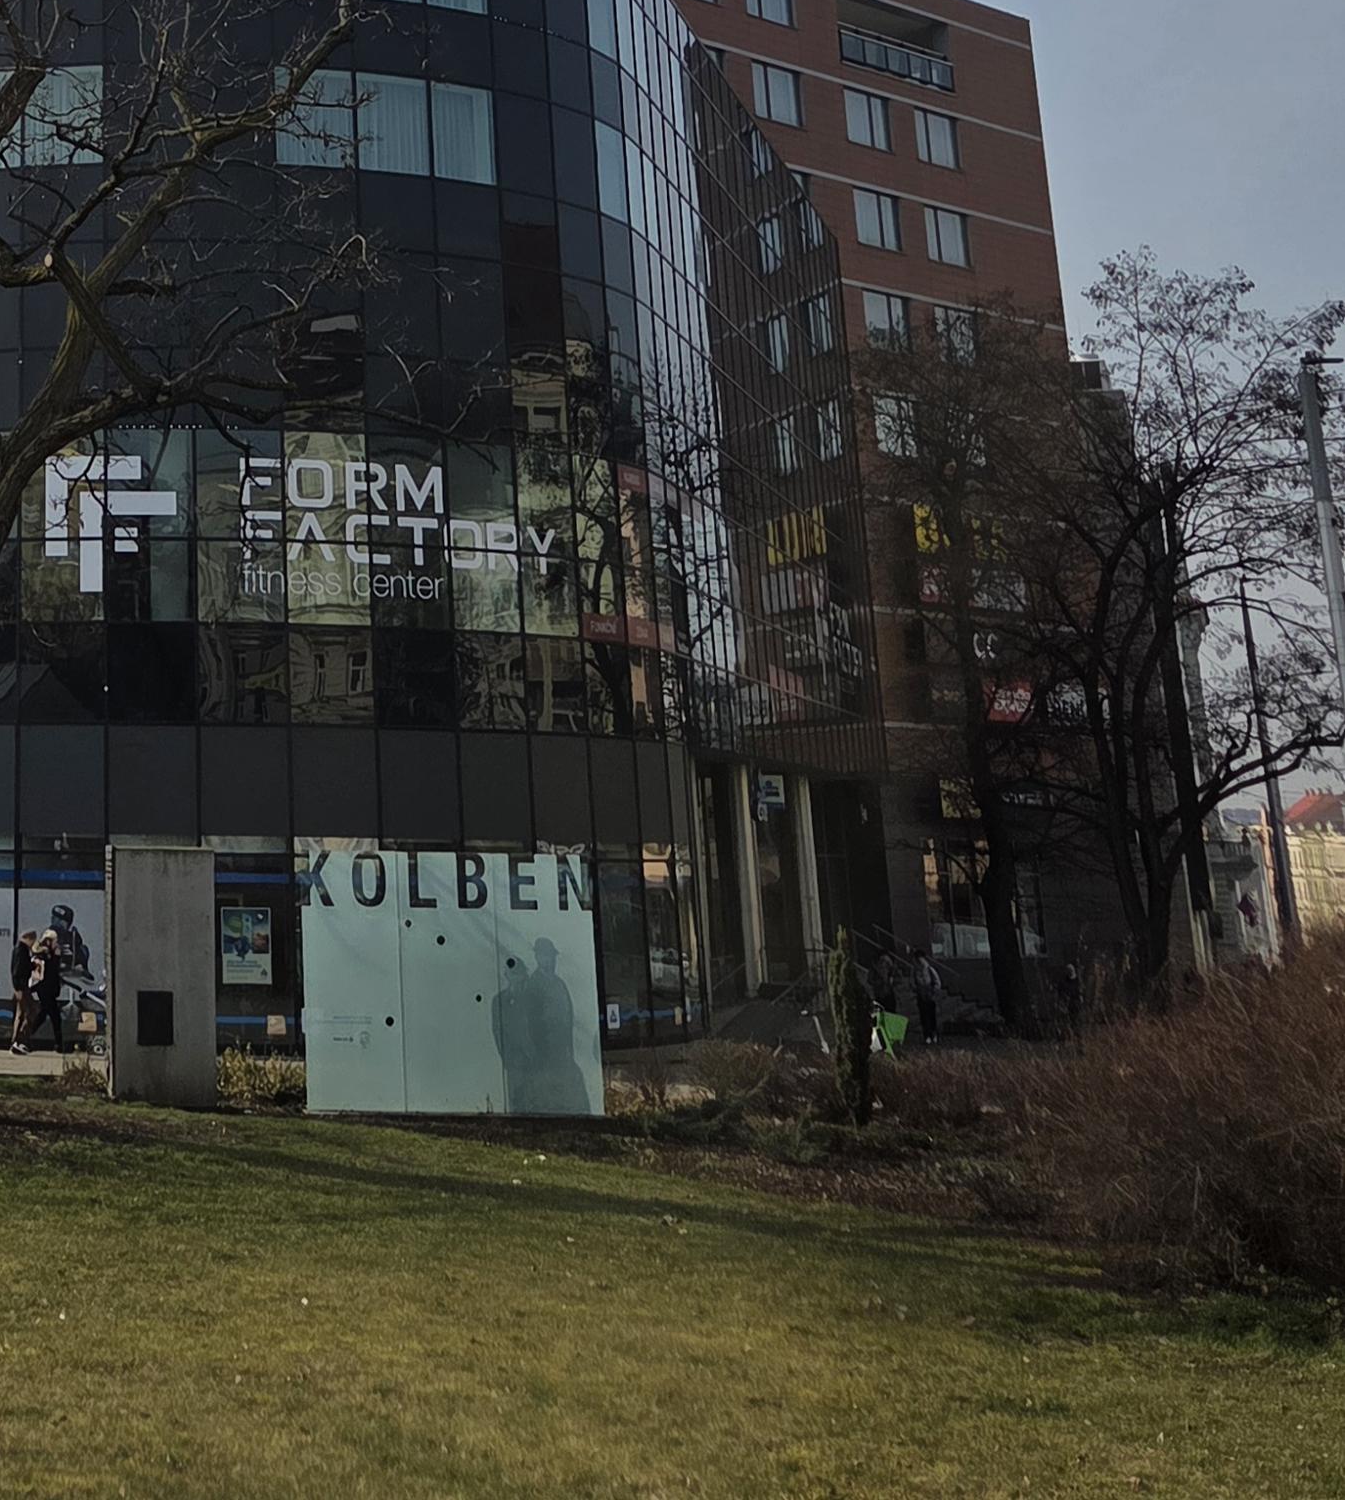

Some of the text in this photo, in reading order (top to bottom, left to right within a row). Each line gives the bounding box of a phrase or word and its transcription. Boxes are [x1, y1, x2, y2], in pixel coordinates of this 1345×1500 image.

[239, 457, 444, 515] FORM
[239, 510, 555, 575] FACTORY
[240, 562, 445, 601] fitness center
[304, 850, 593, 911] KOLBEN
